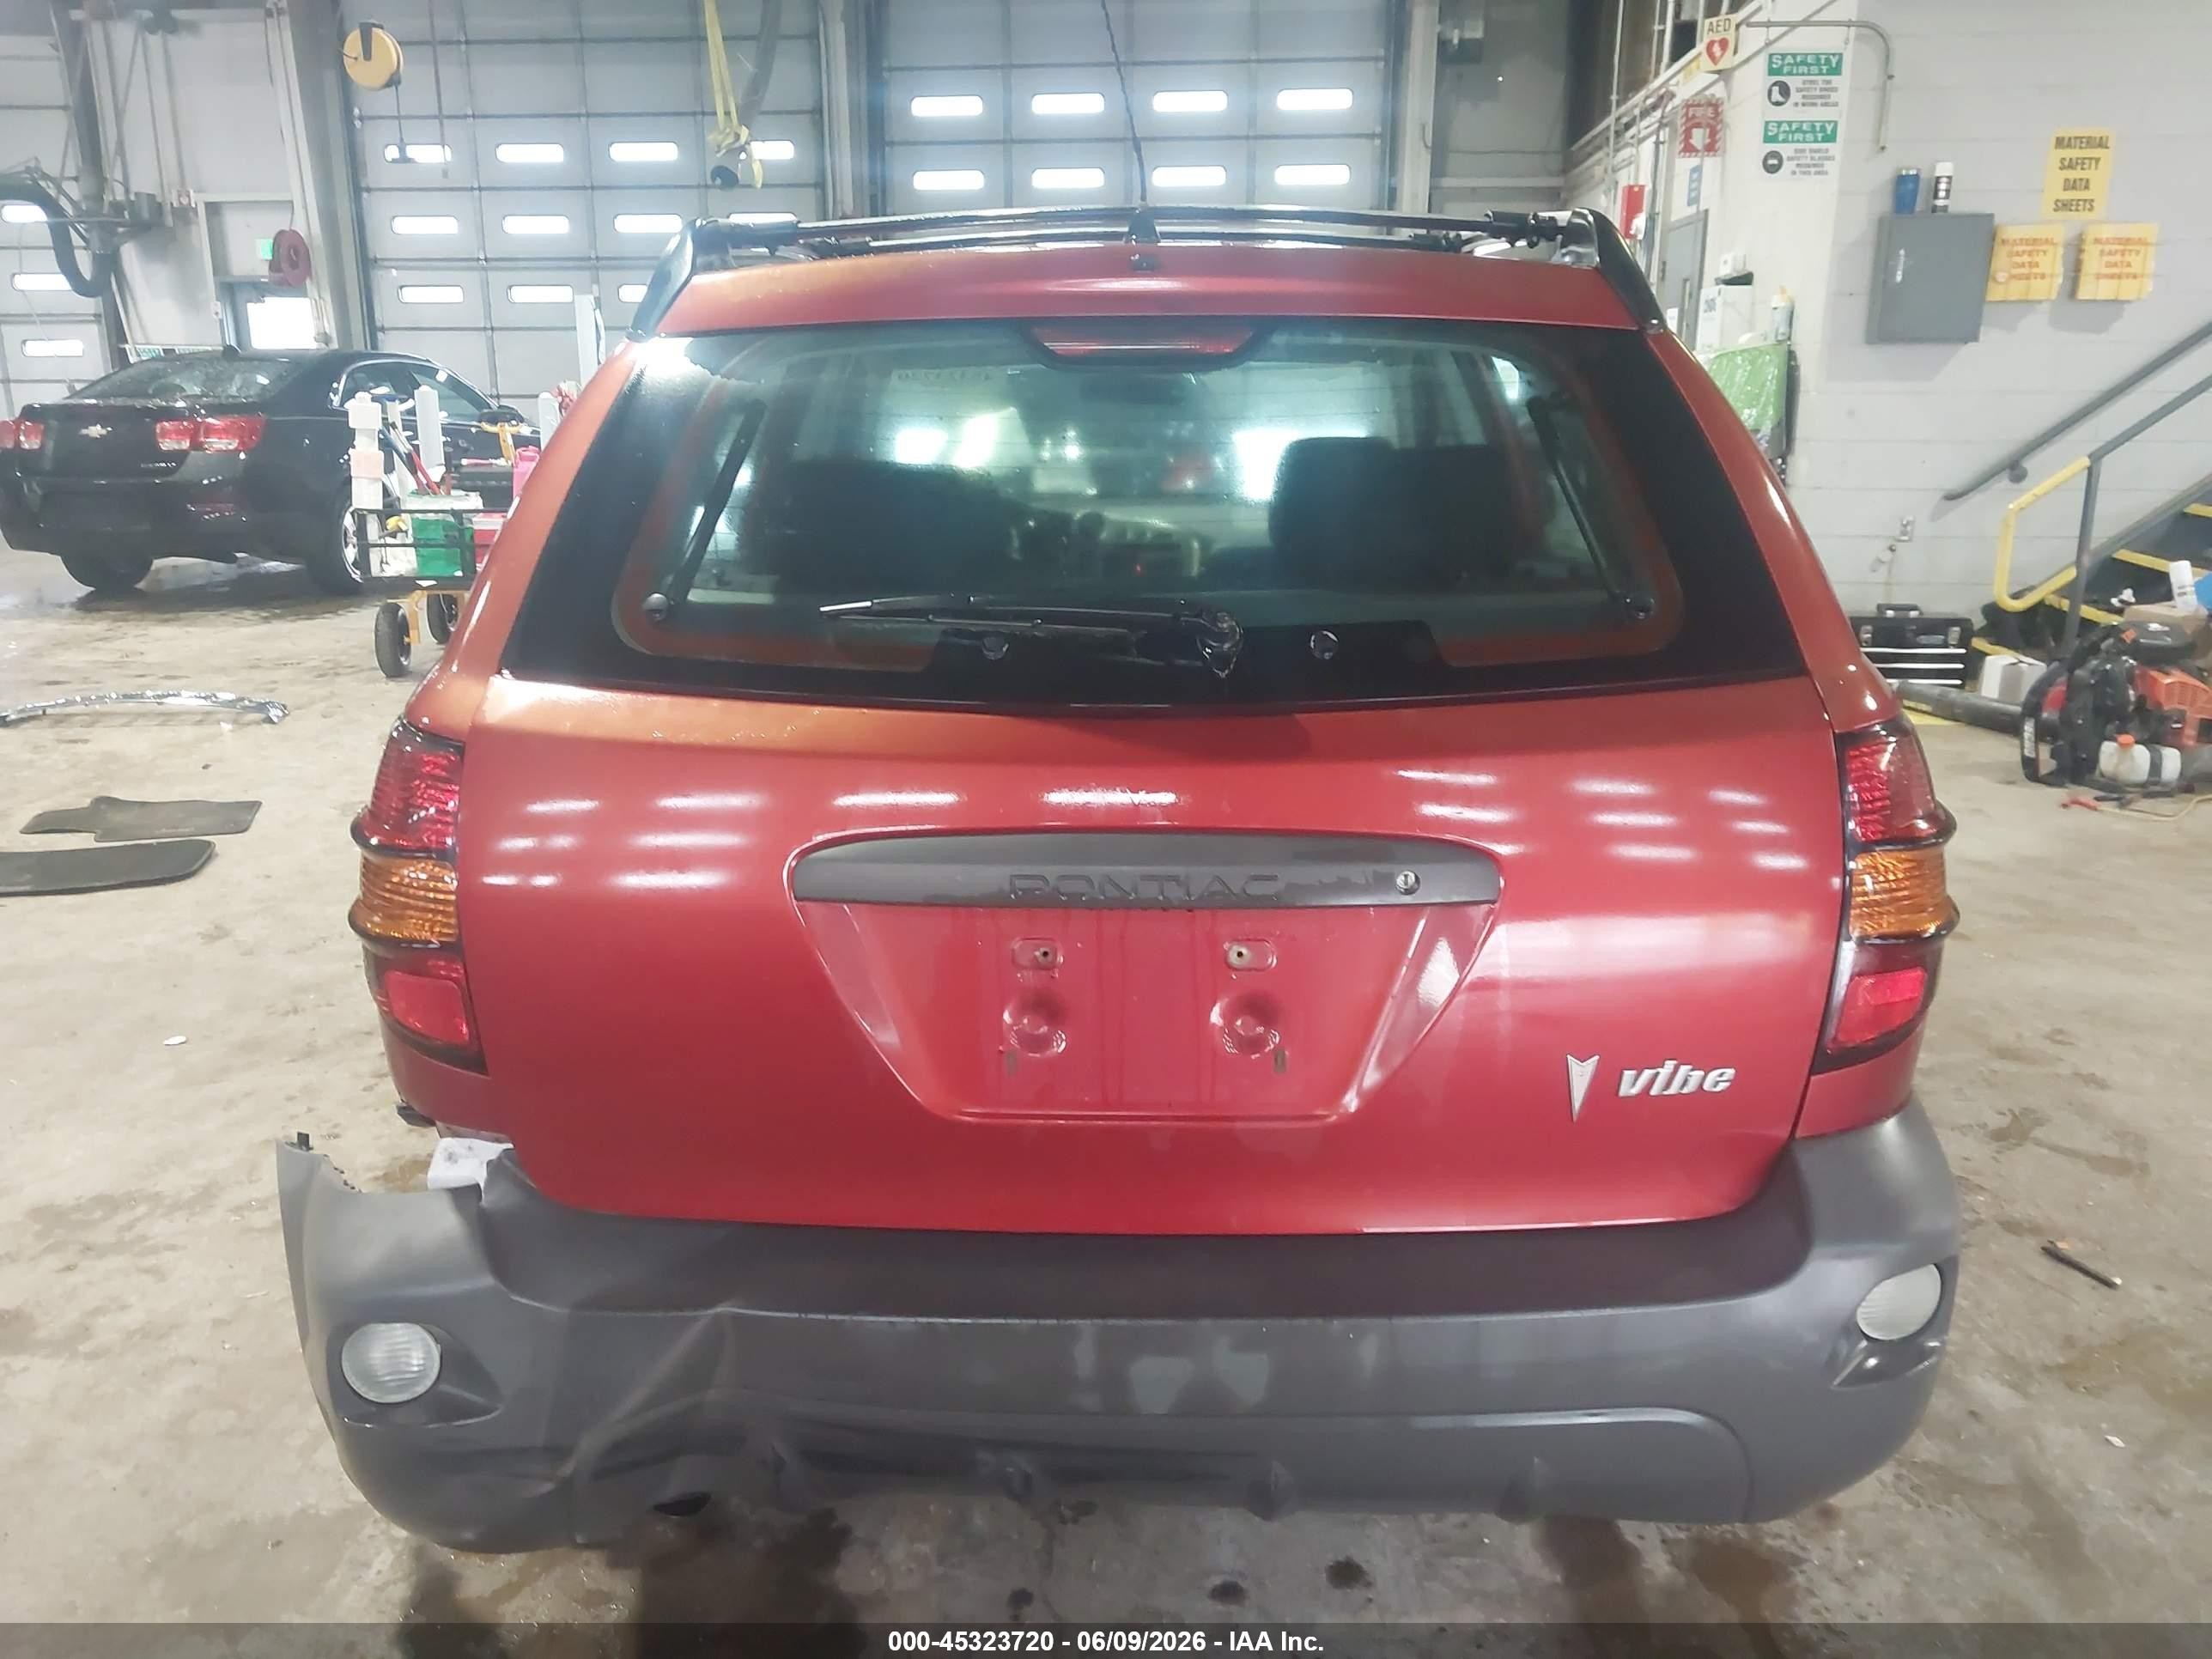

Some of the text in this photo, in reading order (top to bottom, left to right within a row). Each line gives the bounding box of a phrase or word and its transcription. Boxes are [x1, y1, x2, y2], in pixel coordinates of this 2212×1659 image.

[1707, 17, 1731, 34] AED
[1771, 54, 1839, 68] SAFETY
[1783, 65, 1830, 74] FIRST
[1767, 122, 1835, 136] SAFETY
[1778, 133, 1825, 142] FIRST
[2054, 136, 2110, 149] MATERIAL
[2059, 157, 2101, 171] SAFETY
[2063, 178, 2090, 191] DATA
[2053, 198, 2095, 212] SHEETS
[1010, 874, 1279, 900] PONTIAC
[1619, 1058, 1736, 1097] vibe
